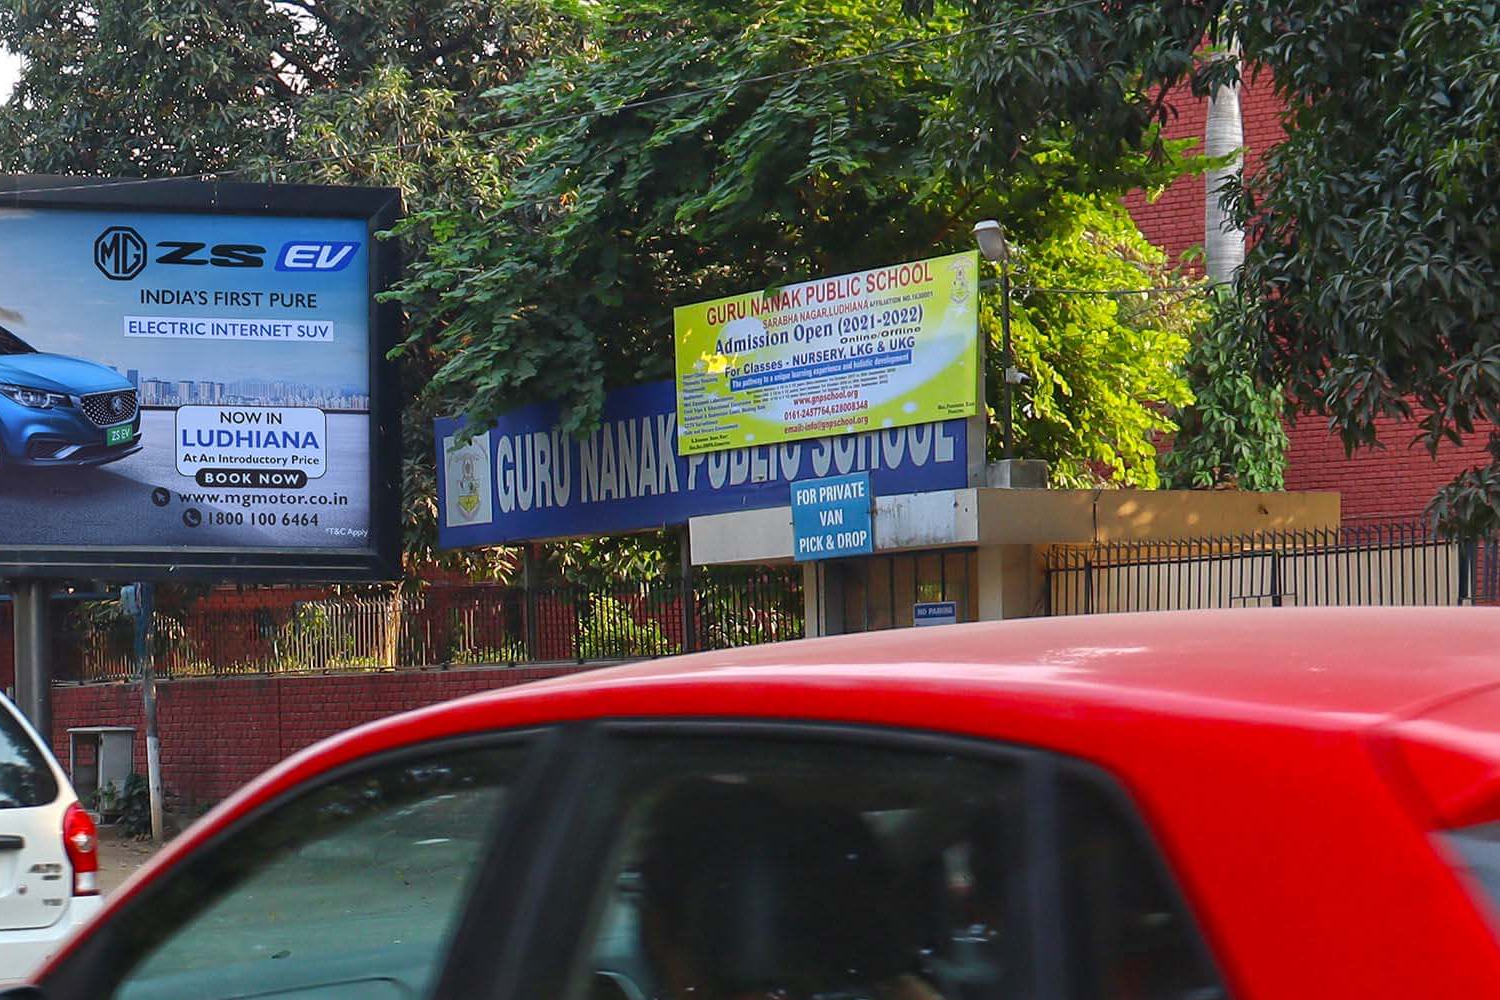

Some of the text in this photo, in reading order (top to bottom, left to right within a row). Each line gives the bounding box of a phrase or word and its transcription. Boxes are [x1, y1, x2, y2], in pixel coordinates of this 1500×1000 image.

[100, 232, 353, 275] MG ZS EV
[140, 289, 317, 308] INDIA’S FIRST PURE
[707, 262, 933, 326] GURU NANAK PUBLIC SCHOOL
[128, 320, 328, 338] ELECTRIC INTERNET SUV
[716, 303, 924, 355] Admission Open (2021-2022)
[763, 313, 799, 329] SARABHA
[725, 367, 740, 378] For
[743, 360, 783, 374] Classes
[792, 347, 846, 366] NURSERY,
[850, 343, 873, 357] LKG
[877, 341, 885, 352] &
[890, 336, 915, 350] UKG
[220, 411, 282, 425] NOW IN
[182, 429, 320, 449] LUDHIANA
[183, 453, 320, 467] At An Introductory Price
[497, 431, 571, 513] GURU
[580, 413, 679, 503] NANAK
[204, 472, 299, 485] BOOK NOW
[179, 492, 348, 507] www.mgmotor.co.in
[796, 481, 864, 505] FOR PRIVATE
[209, 511, 318, 526] 1800 100 6464
[820, 509, 843, 526] VAN
[347, 527, 369, 538] Apply
[800, 530, 867, 553] PICK & DROP
